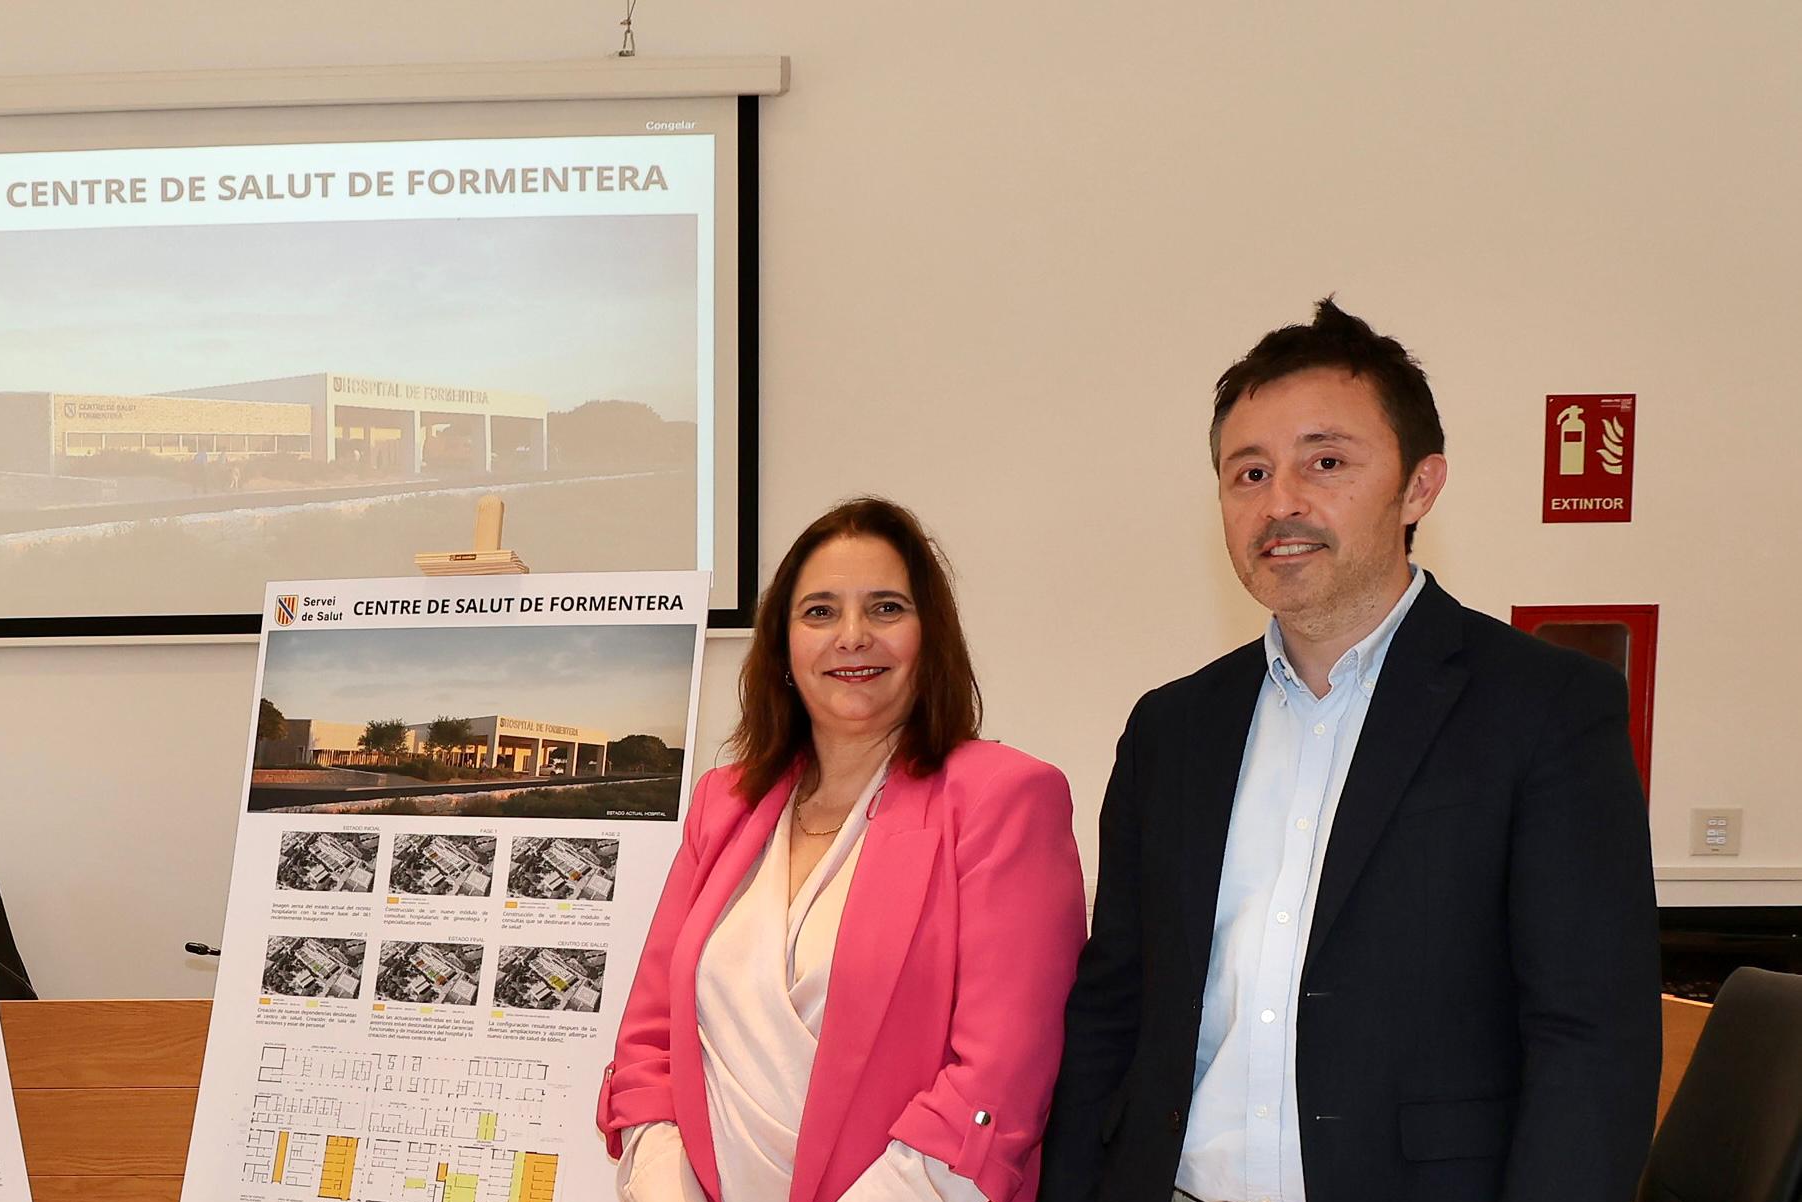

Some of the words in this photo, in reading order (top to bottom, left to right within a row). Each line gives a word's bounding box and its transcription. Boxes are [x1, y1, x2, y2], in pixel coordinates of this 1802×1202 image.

[645, 120, 695, 131] Congelar
[6, 177, 147, 208] CENTRE
[160, 176, 206, 202] DE
[218, 172, 336, 201] SALUT
[349, 171, 394, 197] DE
[407, 165, 669, 195] FORMENTERA
[342, 377, 401, 398] HOSPITAL
[405, 385, 421, 399] DE
[1551, 498, 1624, 510] EXTINTOR
[303, 596, 336, 607] Servei
[353, 599, 421, 616] CENTRE
[427, 599, 450, 614] DE
[455, 597, 515, 614] SALUT
[519, 597, 544, 613] DE
[549, 594, 684, 612] FORMENTERA
[301, 612, 313, 622] de
[317, 611, 343, 622] Salut
